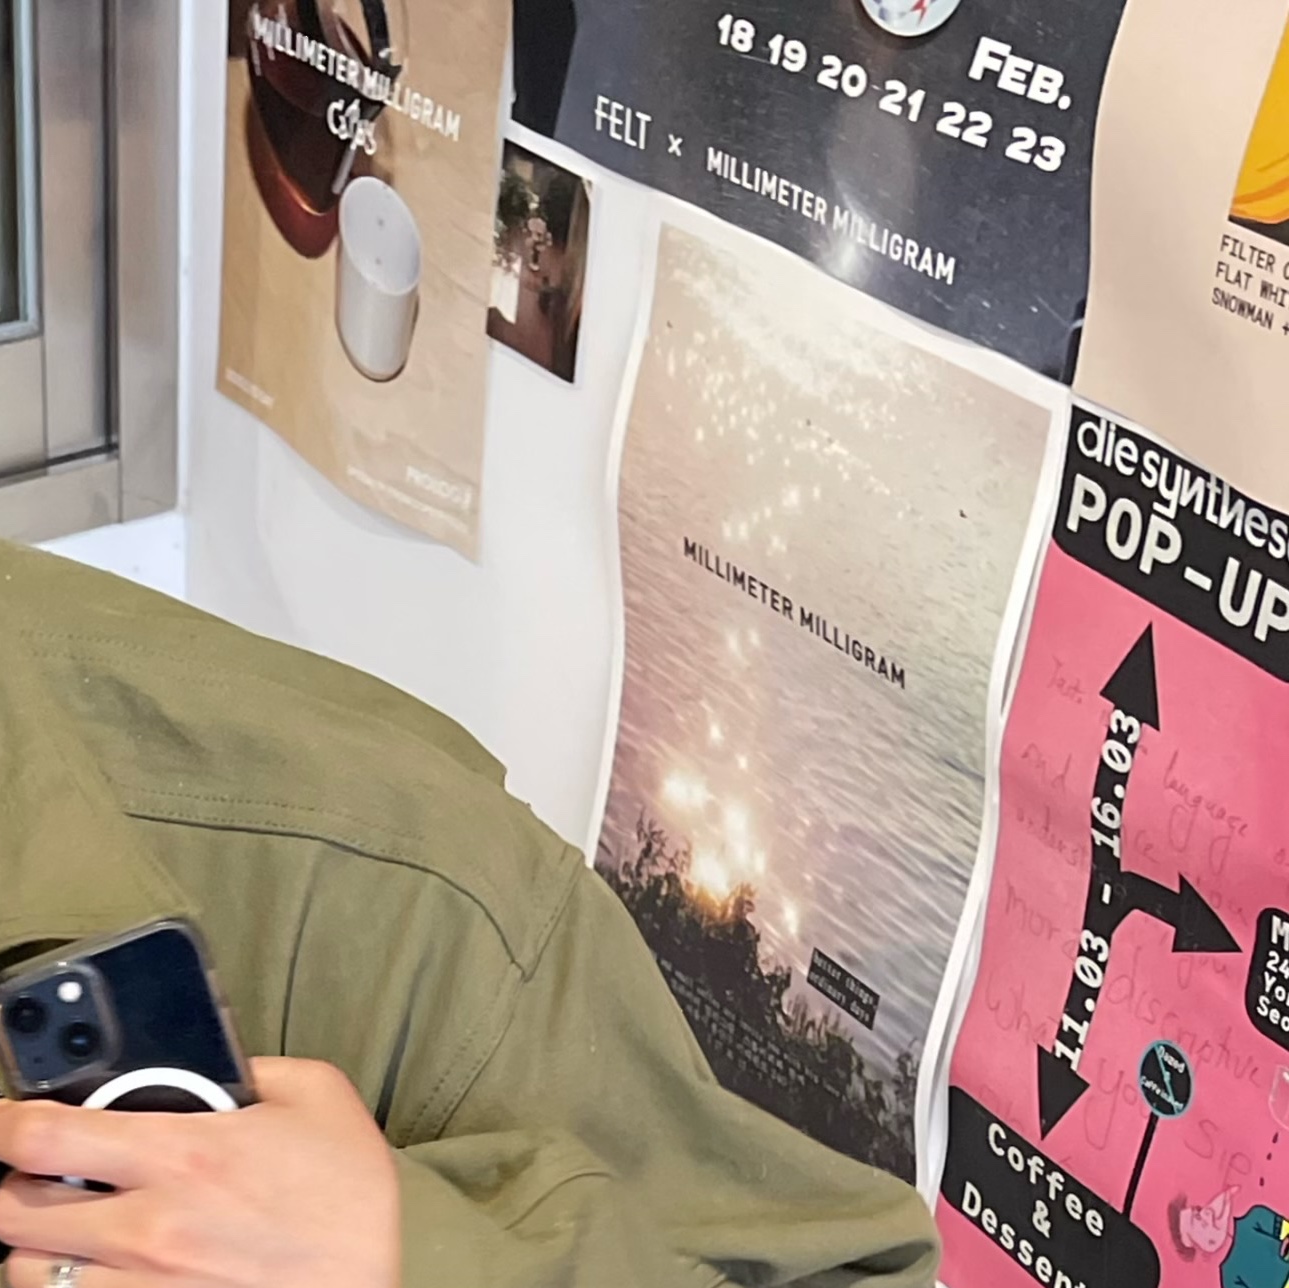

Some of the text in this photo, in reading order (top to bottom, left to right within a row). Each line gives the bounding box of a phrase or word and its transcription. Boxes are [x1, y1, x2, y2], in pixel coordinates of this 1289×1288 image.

[253, 12, 461, 141] MILLIMETER MILLIGRAM
[717, 14, 1066, 172] 18 19 20 21 22 23
[968, 36, 1072, 110] FEB.
[595, 95, 653, 150] FELT
[707, 147, 827, 226] MILLIMETER
[832, 206, 956, 285] MILLIGRAM
[1212, 287, 1274, 331] SNOWMAN
[1215, 261, 1289, 309] FLAT WHI
[1220, 234, 1276, 275] FILTER
[683, 537, 907, 691] MILLIMETER MILLIGRAM
[1066, 473, 1289, 642] POP-UP
[1054, 929, 1110, 1073] 11.03
[1091, 709, 1142, 859] 16.03
[986, 1122, 1106, 1238] Coffee
[1030, 1199, 1054, 1239] &
